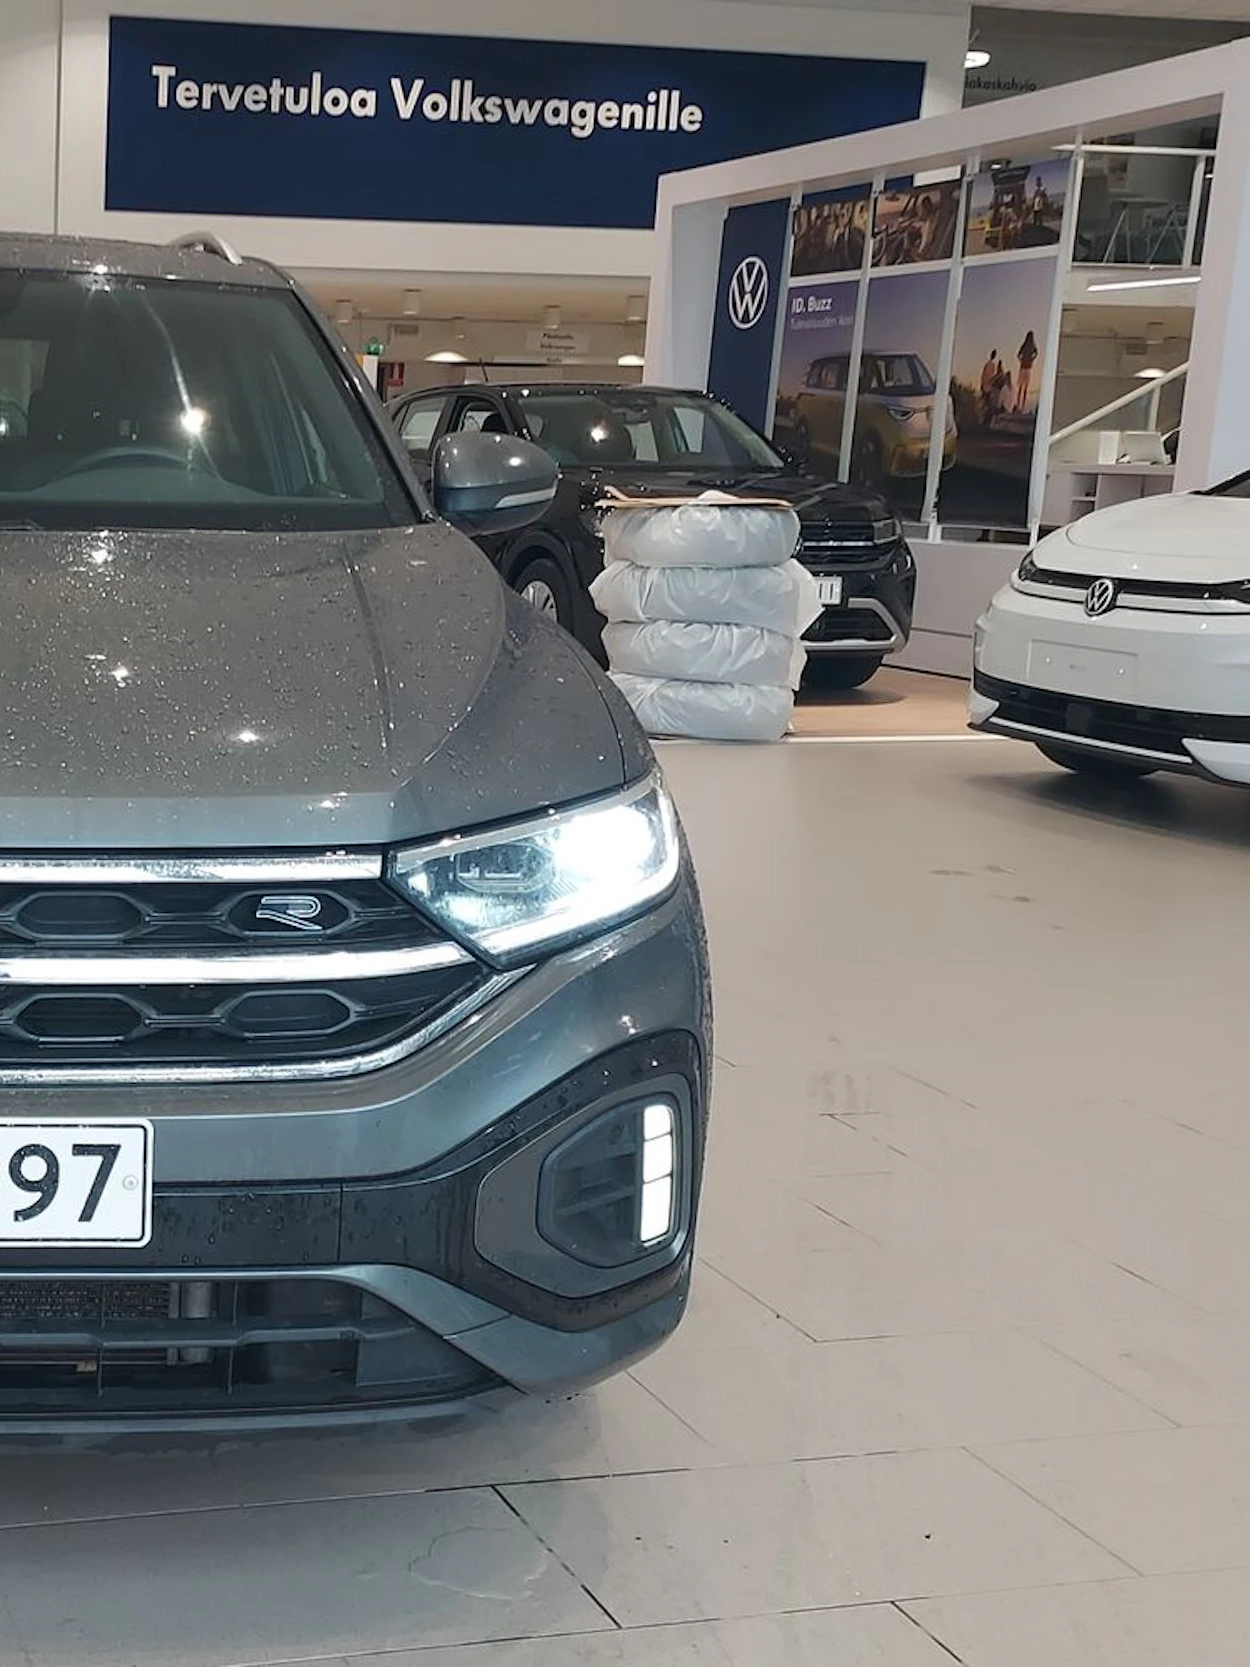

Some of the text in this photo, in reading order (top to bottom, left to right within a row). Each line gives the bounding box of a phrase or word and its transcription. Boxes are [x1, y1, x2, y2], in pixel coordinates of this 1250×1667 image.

[152, 64, 703, 139] Tervetuloa Volkswagenille
[729, 256, 767, 329] VW
[807, 296, 833, 313] Buzz
[255, 895, 323, 931] R
